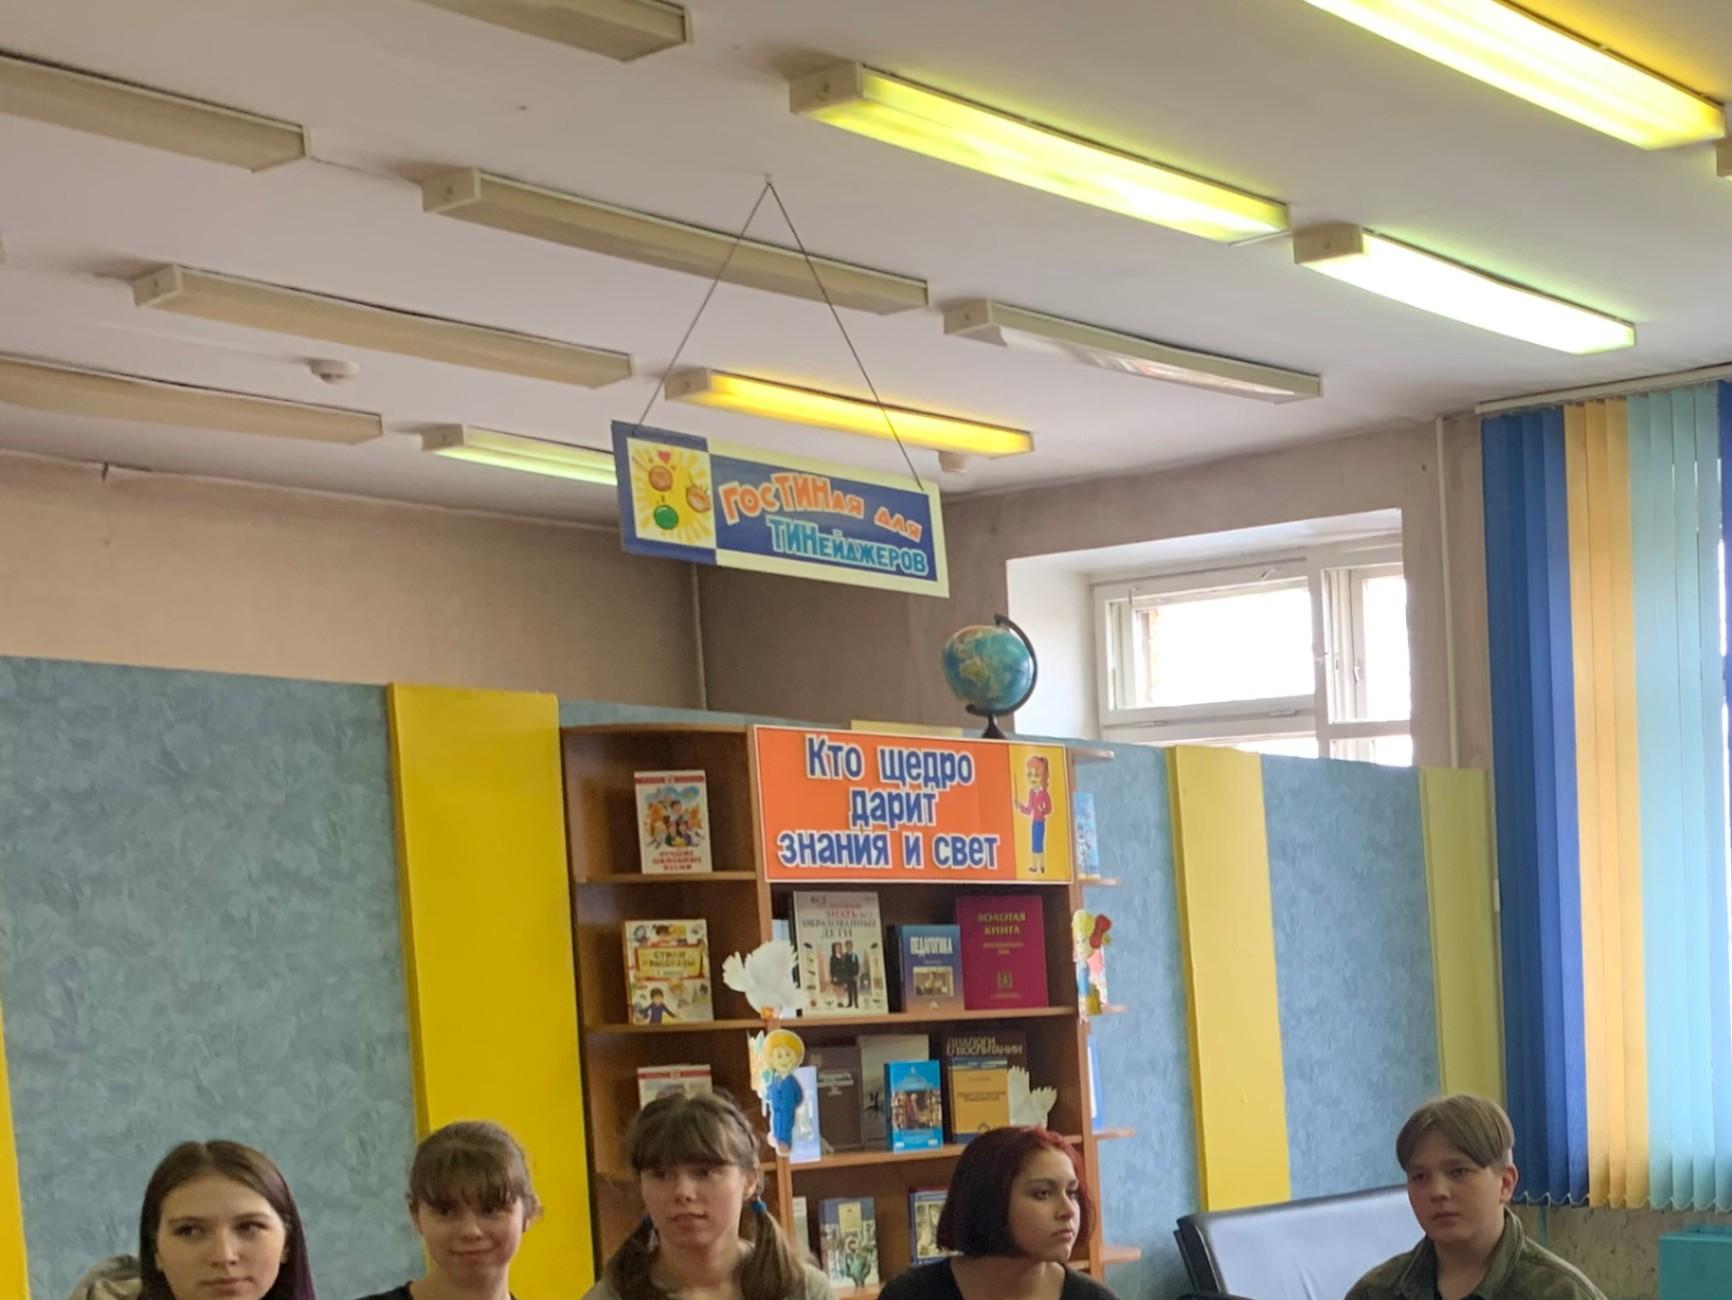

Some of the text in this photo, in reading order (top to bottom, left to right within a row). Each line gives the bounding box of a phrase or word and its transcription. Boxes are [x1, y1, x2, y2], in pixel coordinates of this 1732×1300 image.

[805, 734, 975, 790] Кто щедро
[850, 787, 936, 829] дарит
[777, 827, 998, 869] знания и свет
